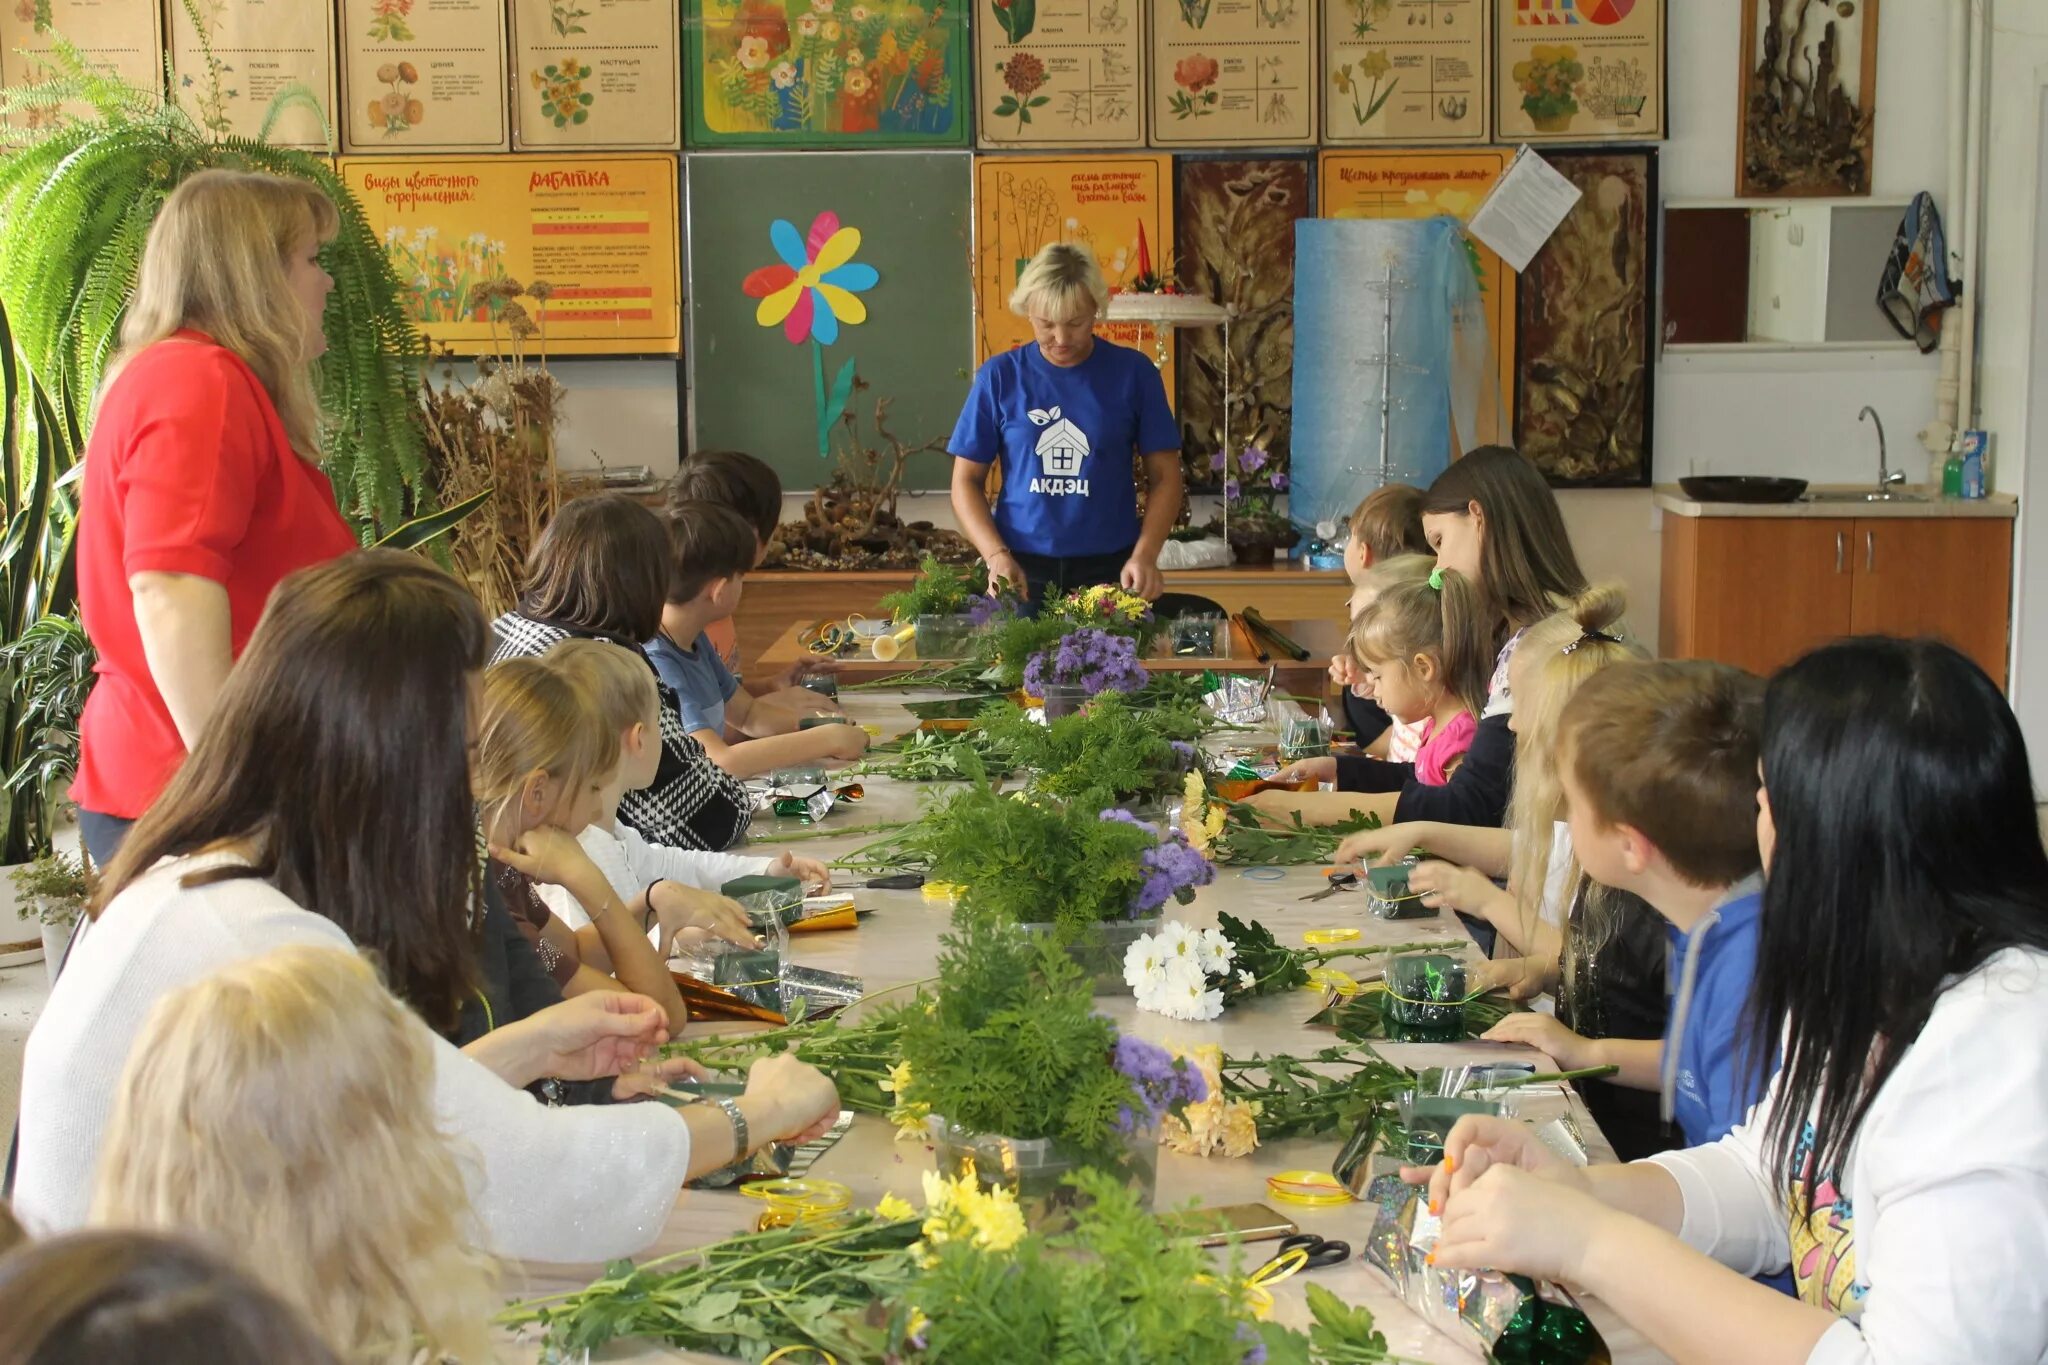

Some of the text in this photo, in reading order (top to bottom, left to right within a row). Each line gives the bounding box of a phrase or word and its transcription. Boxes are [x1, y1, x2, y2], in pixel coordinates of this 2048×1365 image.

[364, 170, 479, 192] Виды цветочного
[1028, 477, 1090, 498] АКДЭЦ
